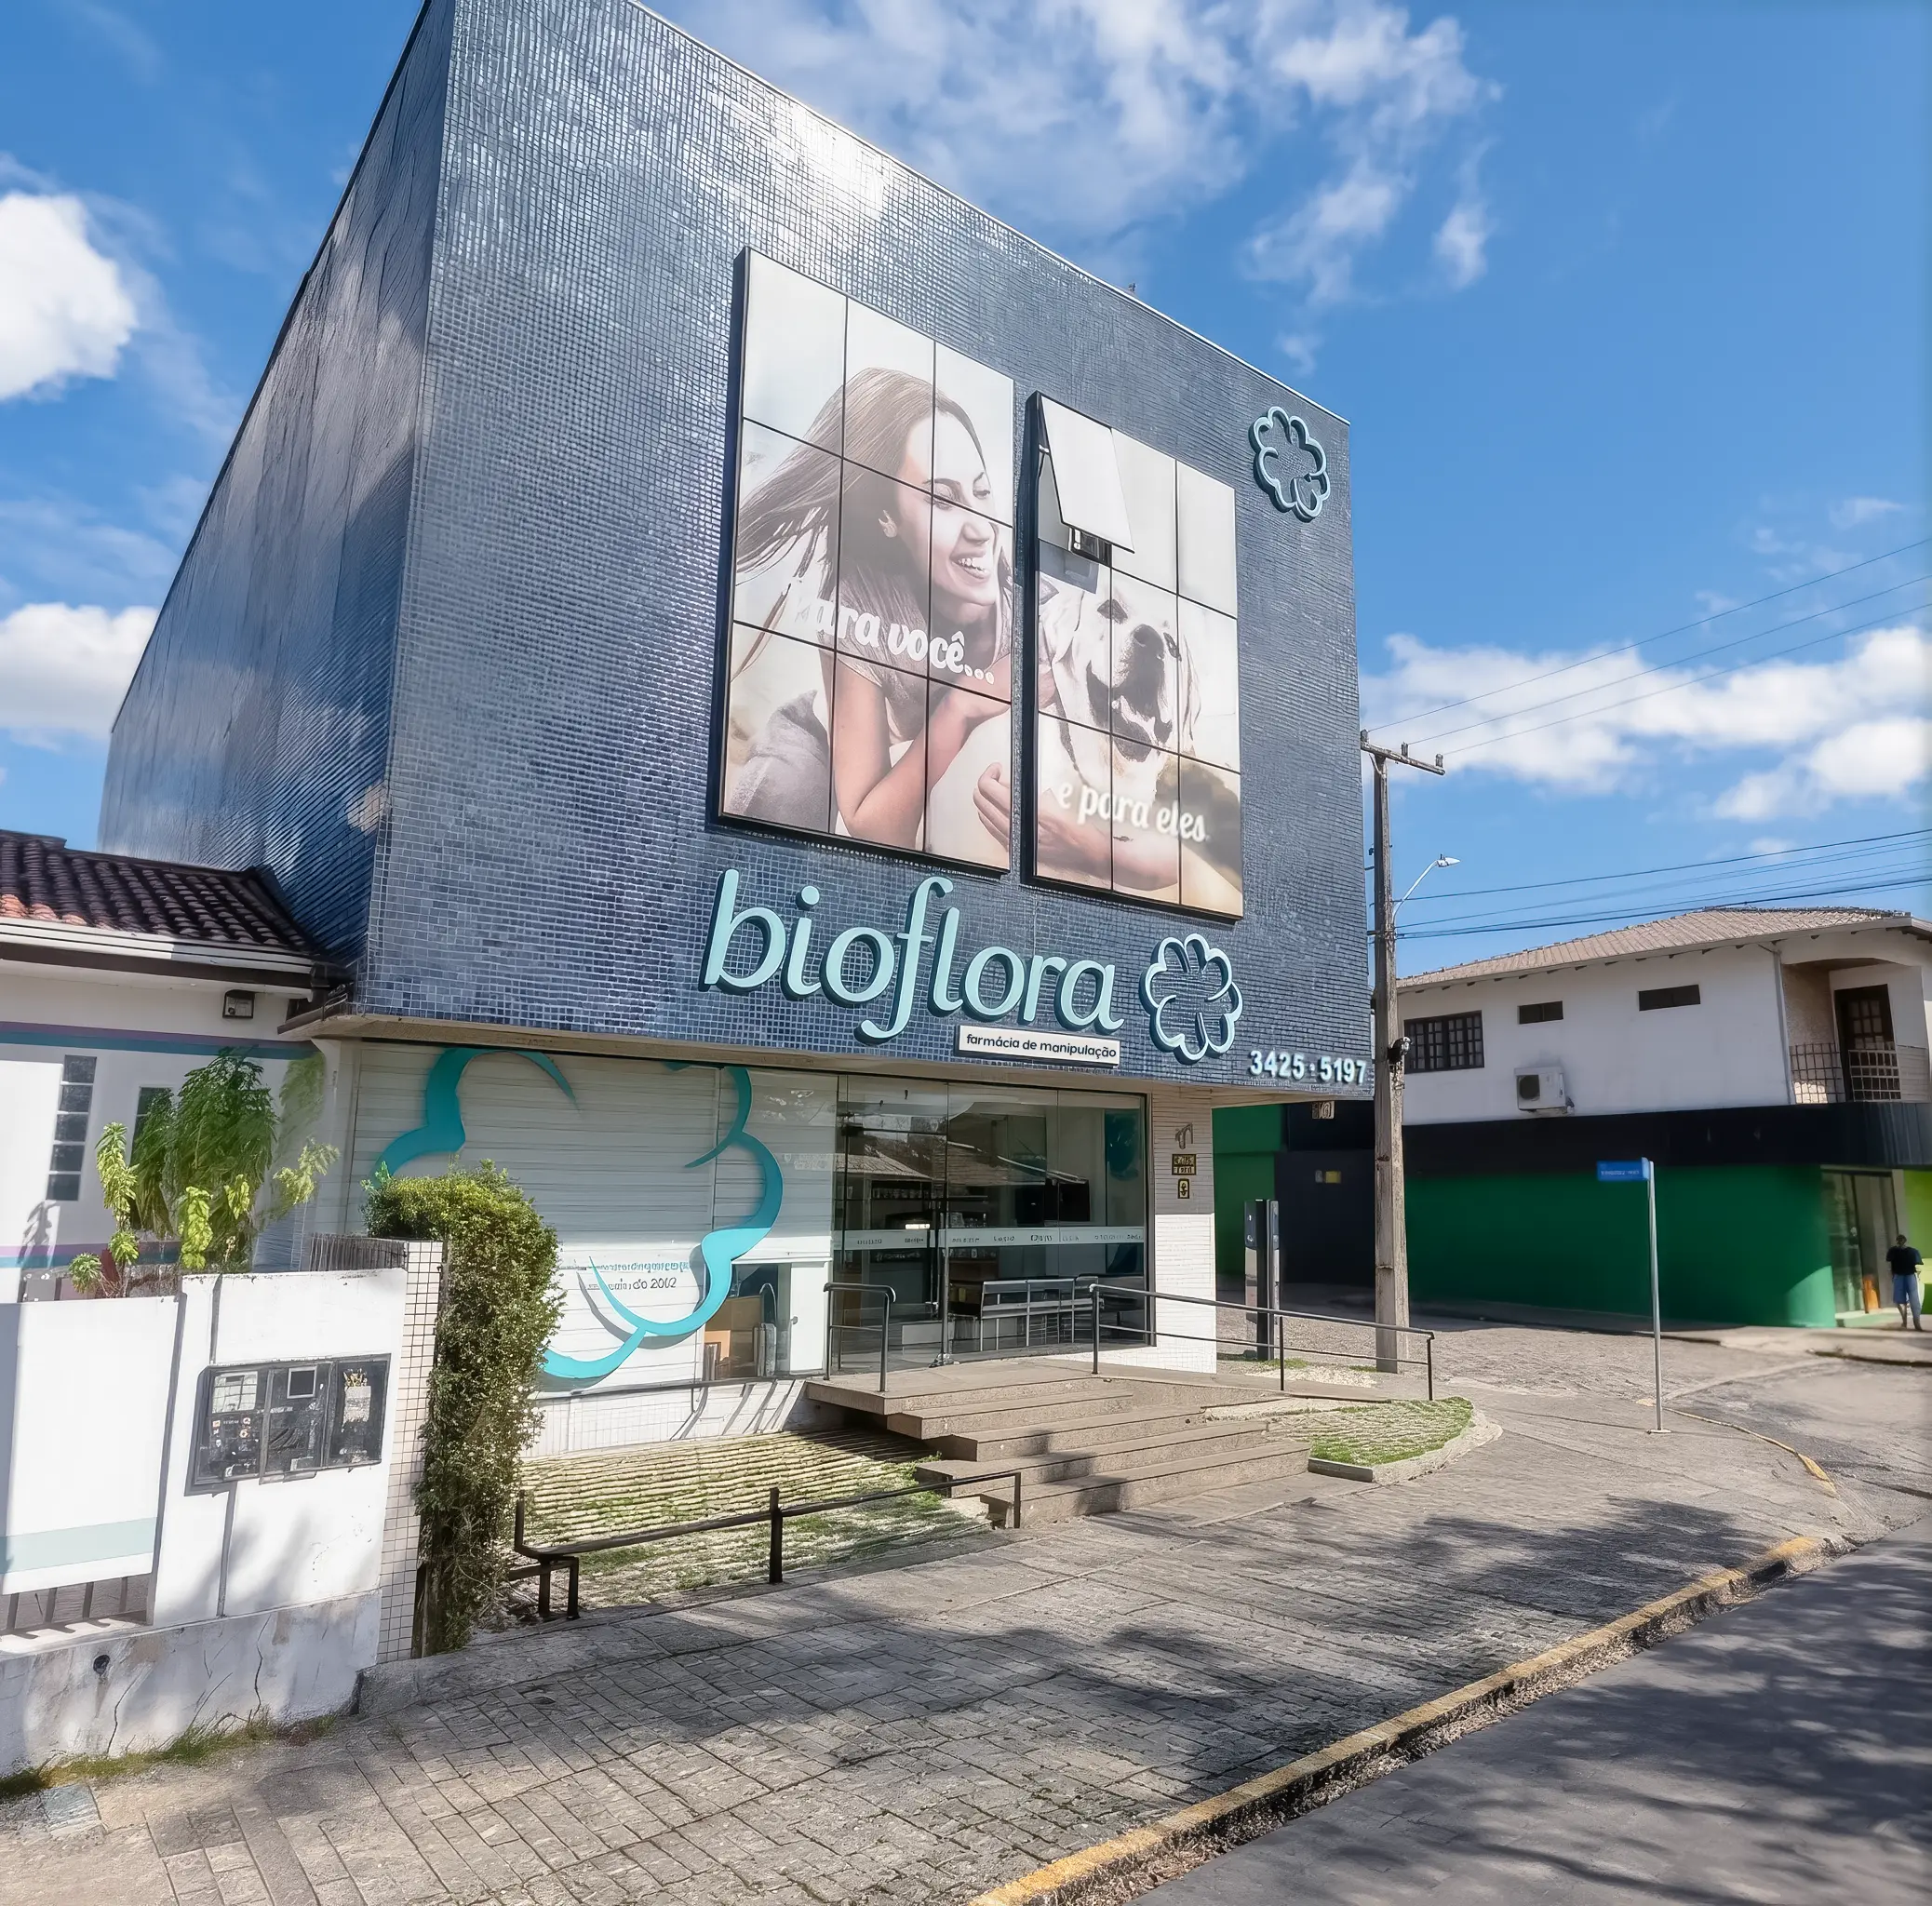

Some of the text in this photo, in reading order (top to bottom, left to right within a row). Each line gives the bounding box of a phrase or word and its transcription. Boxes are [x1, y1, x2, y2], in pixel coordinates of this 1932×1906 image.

[1058, 782, 1074, 810] e
[1077, 785, 1149, 828] para
[703, 868, 1125, 1040] bioflora
[966, 1033, 1117, 1059] farmácia de manipulação
